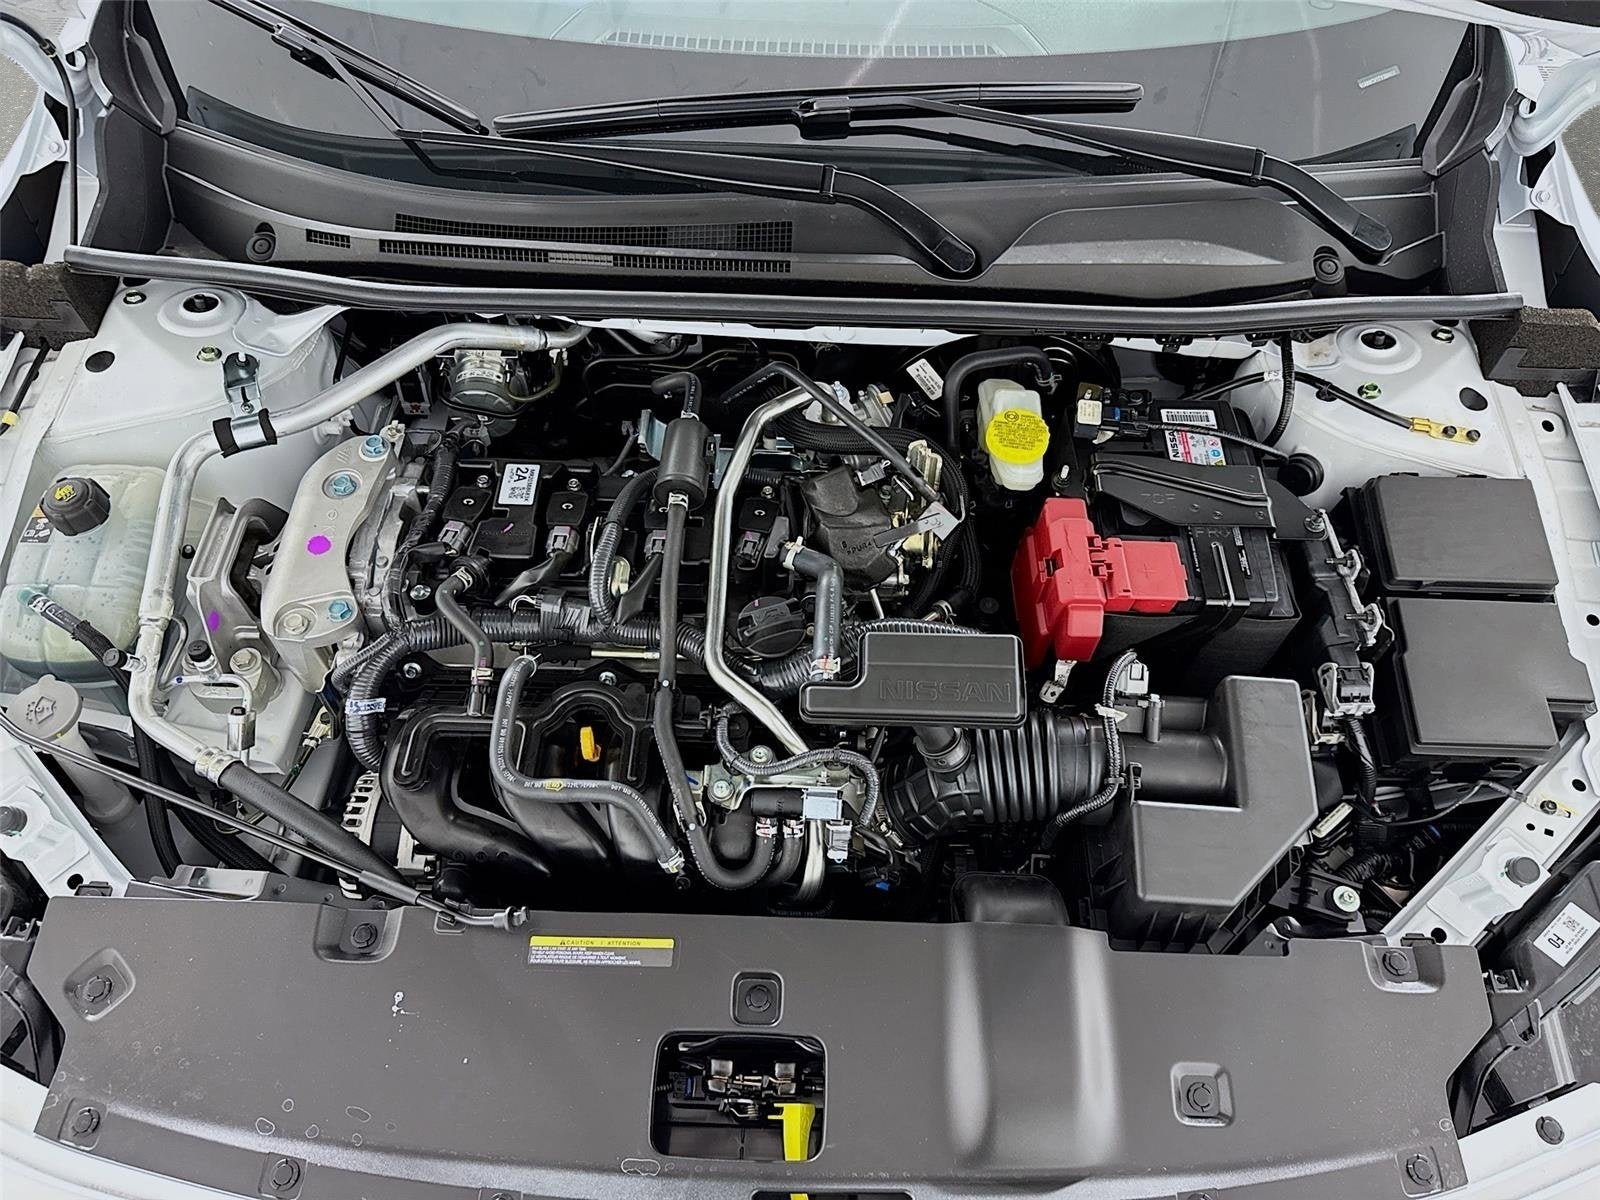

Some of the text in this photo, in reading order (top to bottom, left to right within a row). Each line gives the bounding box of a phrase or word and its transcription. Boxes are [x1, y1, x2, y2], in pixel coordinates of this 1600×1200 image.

[1168, 430, 1180, 459] NISSA
[514, 467, 529, 483] 2A
[463, 498, 475, 506] C
[561, 502, 574, 510] C
[754, 509, 766, 517] C
[879, 679, 1012, 703] NISSAN
